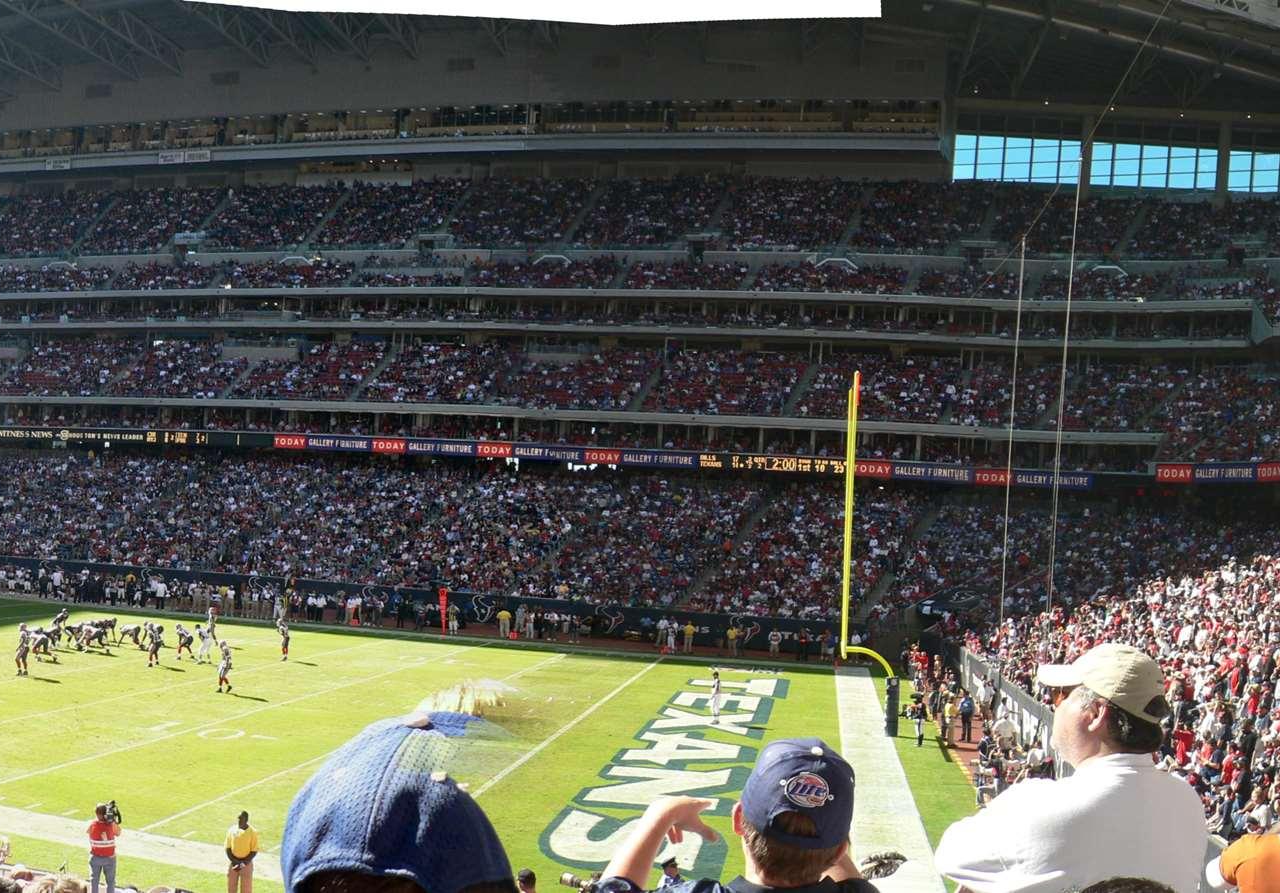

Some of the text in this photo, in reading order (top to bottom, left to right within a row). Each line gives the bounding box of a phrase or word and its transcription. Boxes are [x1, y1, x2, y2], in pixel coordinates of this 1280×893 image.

[274, 437, 306, 447] TODAY
[308, 438, 334, 448] GALLERY
[372, 440, 405, 451] TODAY
[408, 441, 435, 451] GALLERY
[477, 445, 512, 455] TODAY
[515, 446, 542, 456] GALLERY
[584, 451, 620, 461] TODAY
[623, 453, 652, 463] GALLERY
[654, 454, 693, 465] FURNITURE
[773, 458, 796, 470] 2:00
[798, 464, 811, 472] 1st
[855, 464, 890, 474] TODAY
[894, 466, 925, 477] GALLERY
[928, 468, 969, 481] FURNITURE
[976, 473, 1012, 483] TODAY
[1017, 474, 1046, 484] GALLERY
[1157, 468, 1192, 478] TODAY
[1195, 468, 1219, 479] GALLERY
